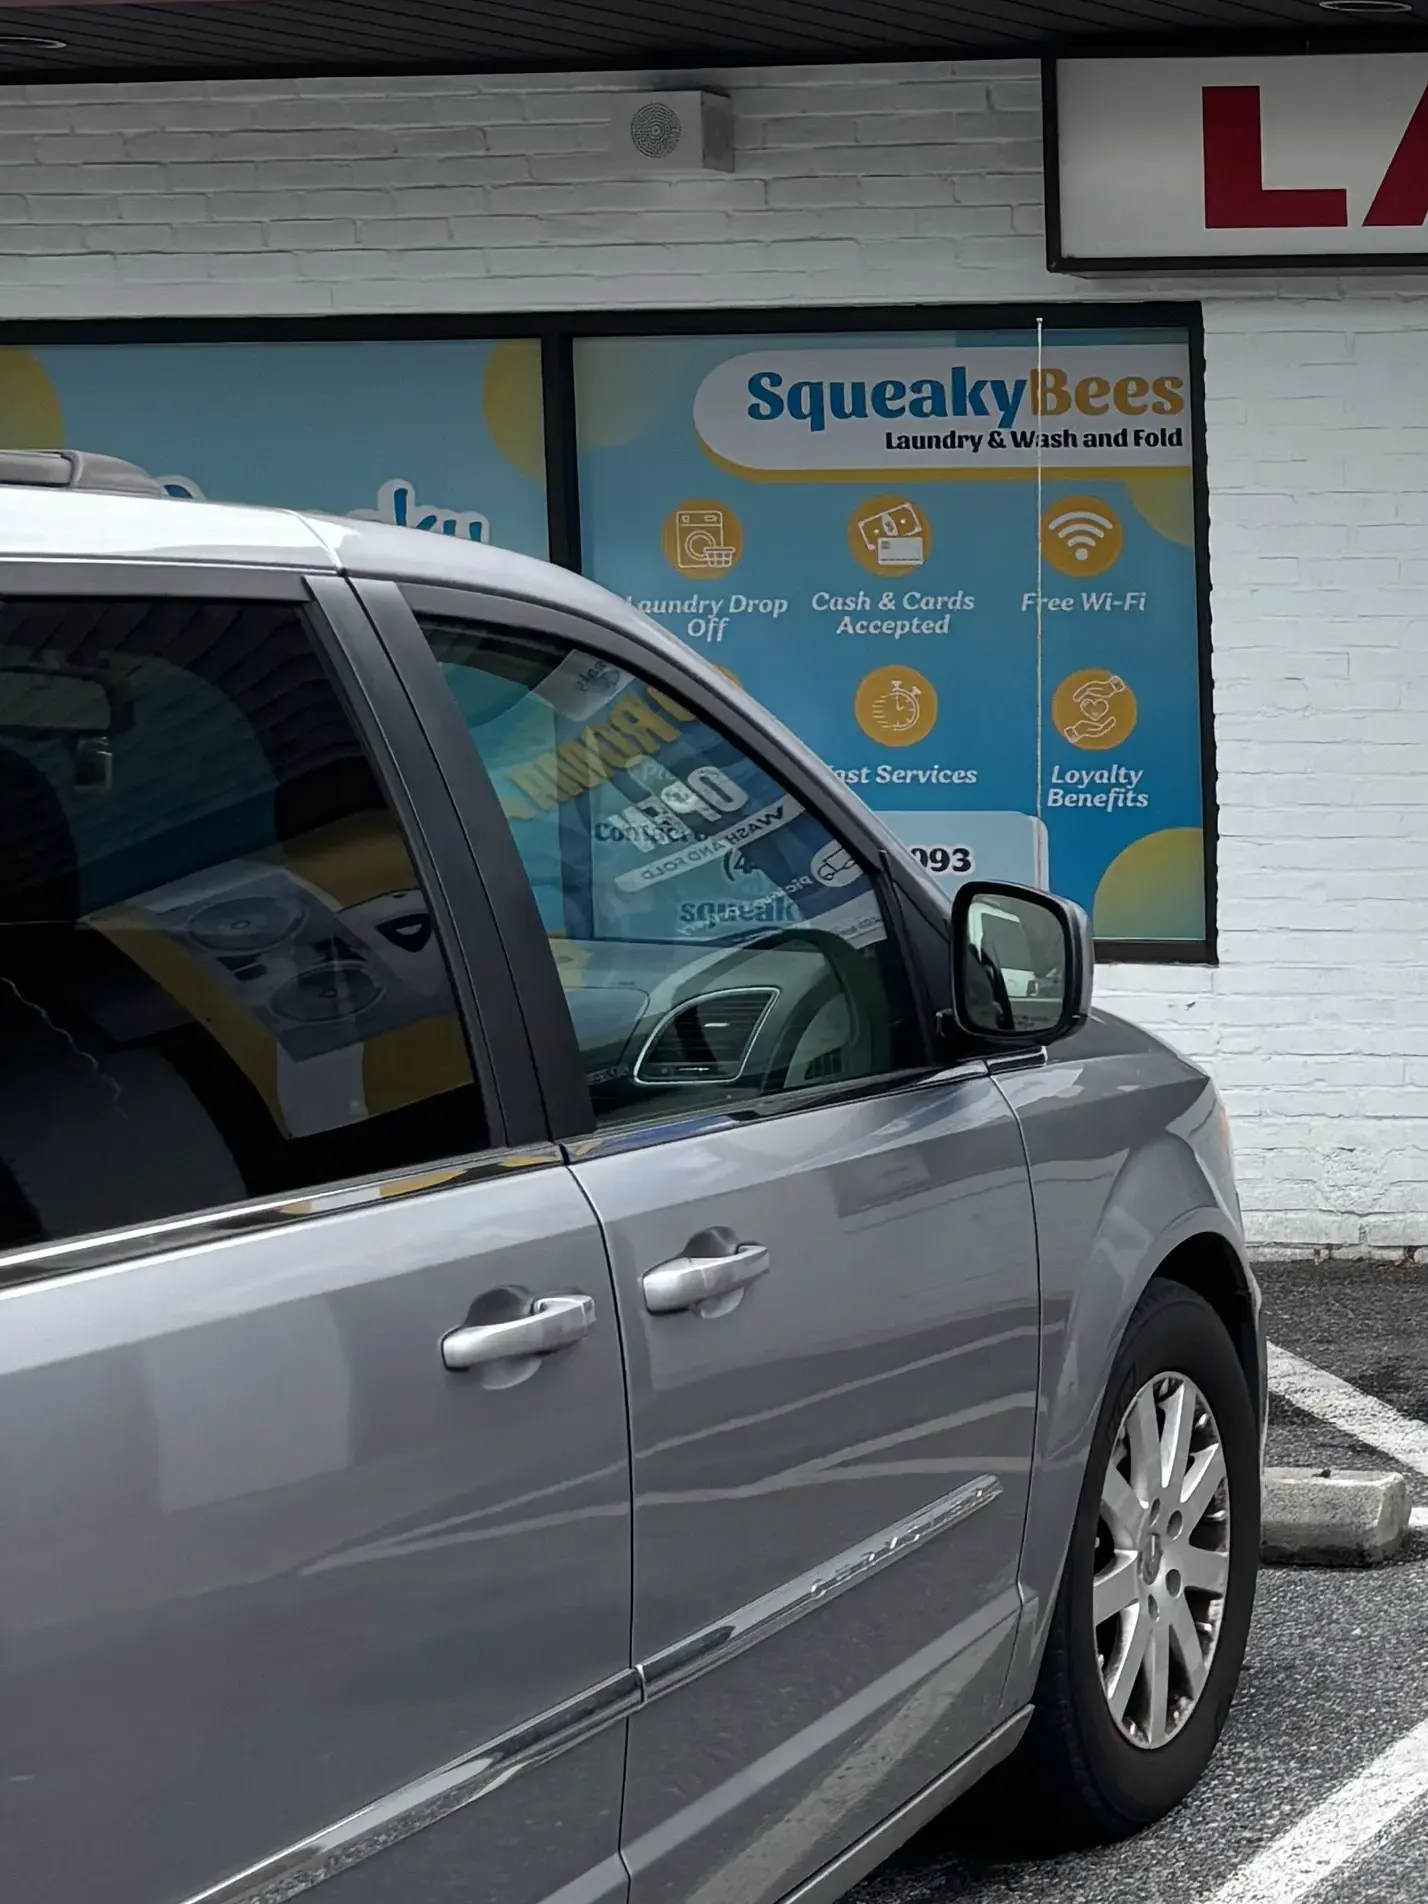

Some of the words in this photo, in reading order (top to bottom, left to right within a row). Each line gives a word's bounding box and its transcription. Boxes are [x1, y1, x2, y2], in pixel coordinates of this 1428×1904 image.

[885, 430, 982, 453] Laundry
[988, 431, 1006, 449] &
[1010, 429, 1078, 449] Wash
[1082, 428, 1129, 448] and
[1133, 427, 1183, 448] Fold
[728, 595, 789, 619] Drop
[811, 591, 871, 612] Cash
[878, 592, 896, 611] &
[902, 591, 975, 612] Cards
[1021, 593, 1074, 612] Free
[1081, 592, 1147, 612] Wi-Fi
[687, 617, 731, 642] Off
[836, 614, 951, 639] Accepted
[828, 764, 872, 784] ast
[876, 764, 978, 785] Services
[1051, 764, 1144, 789] Loyalty
[1047, 788, 1149, 812] Benefits
